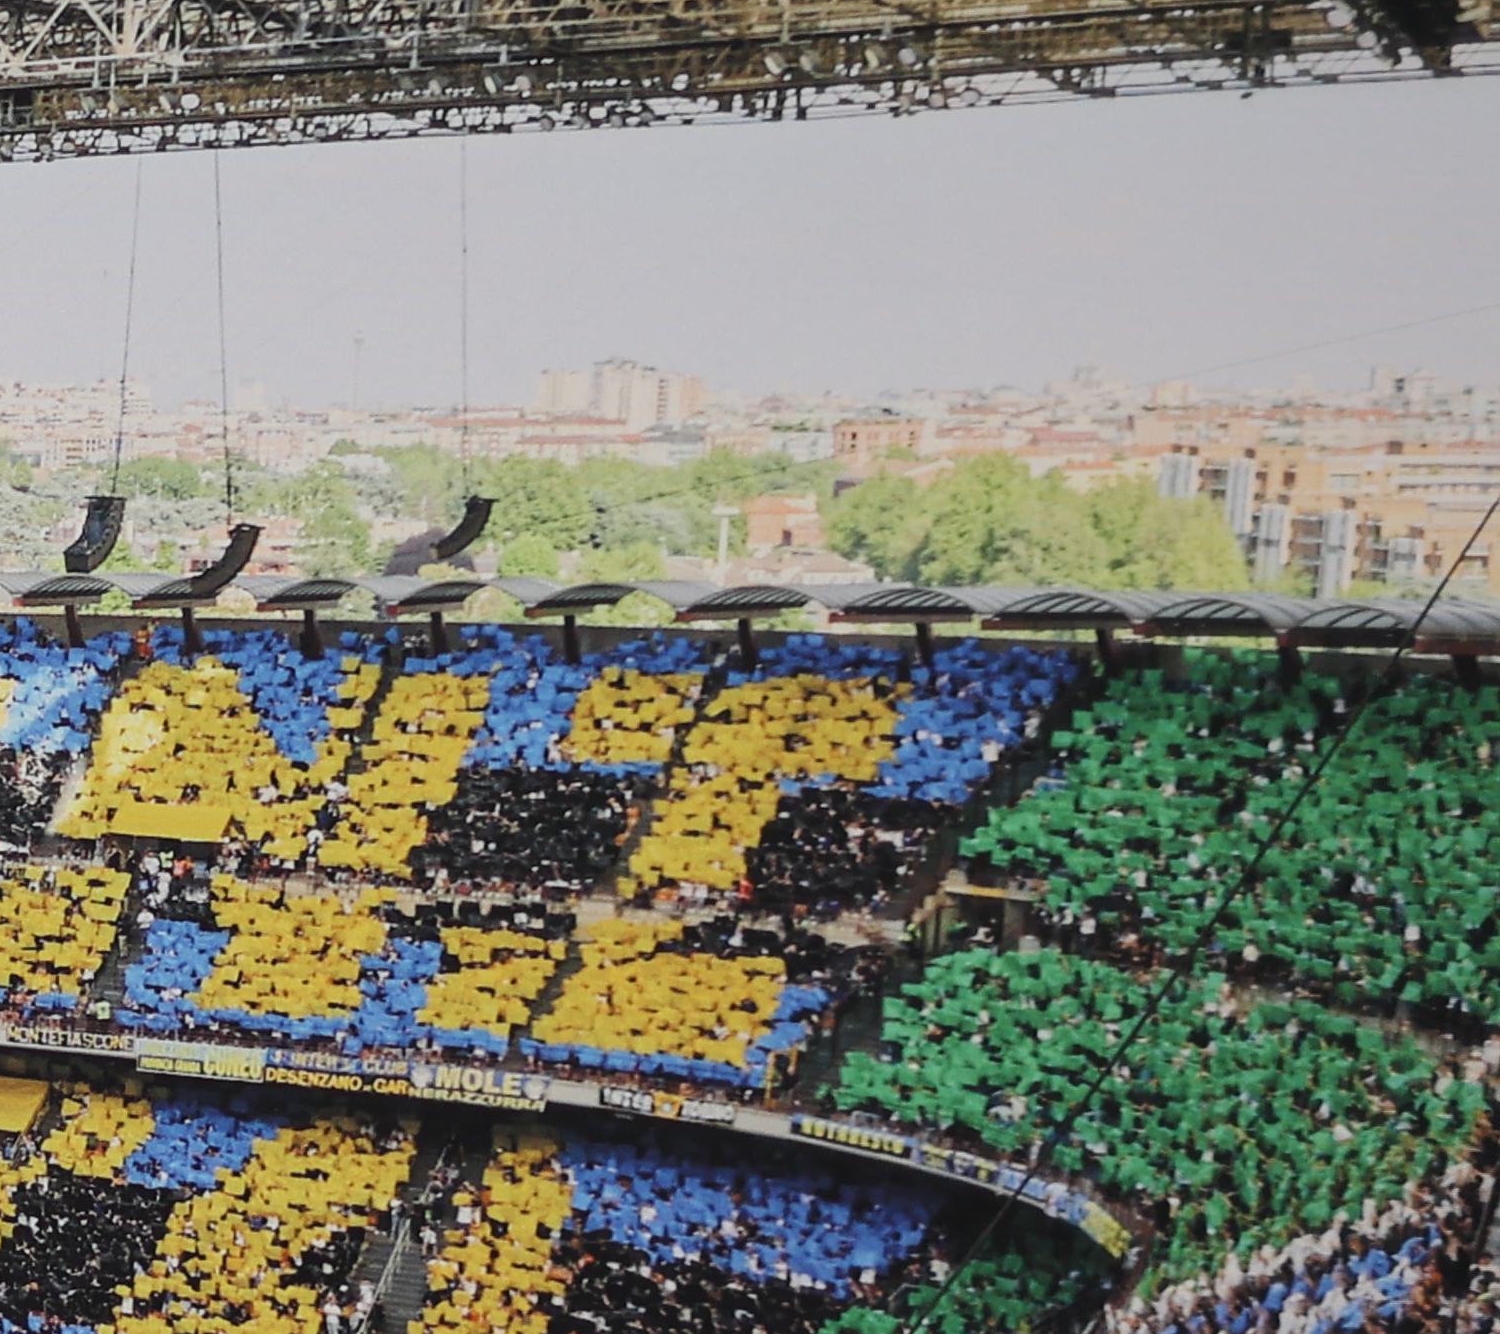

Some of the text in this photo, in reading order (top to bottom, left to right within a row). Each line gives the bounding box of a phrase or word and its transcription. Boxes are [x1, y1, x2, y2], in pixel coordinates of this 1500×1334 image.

[7, 1024, 133, 1051] MONTEFIASCONE
[265, 1067, 411, 1096] DESENZANO GAR
[435, 1066, 521, 1096] MOLE
[409, 1086, 545, 1112] NERAZZURRA
